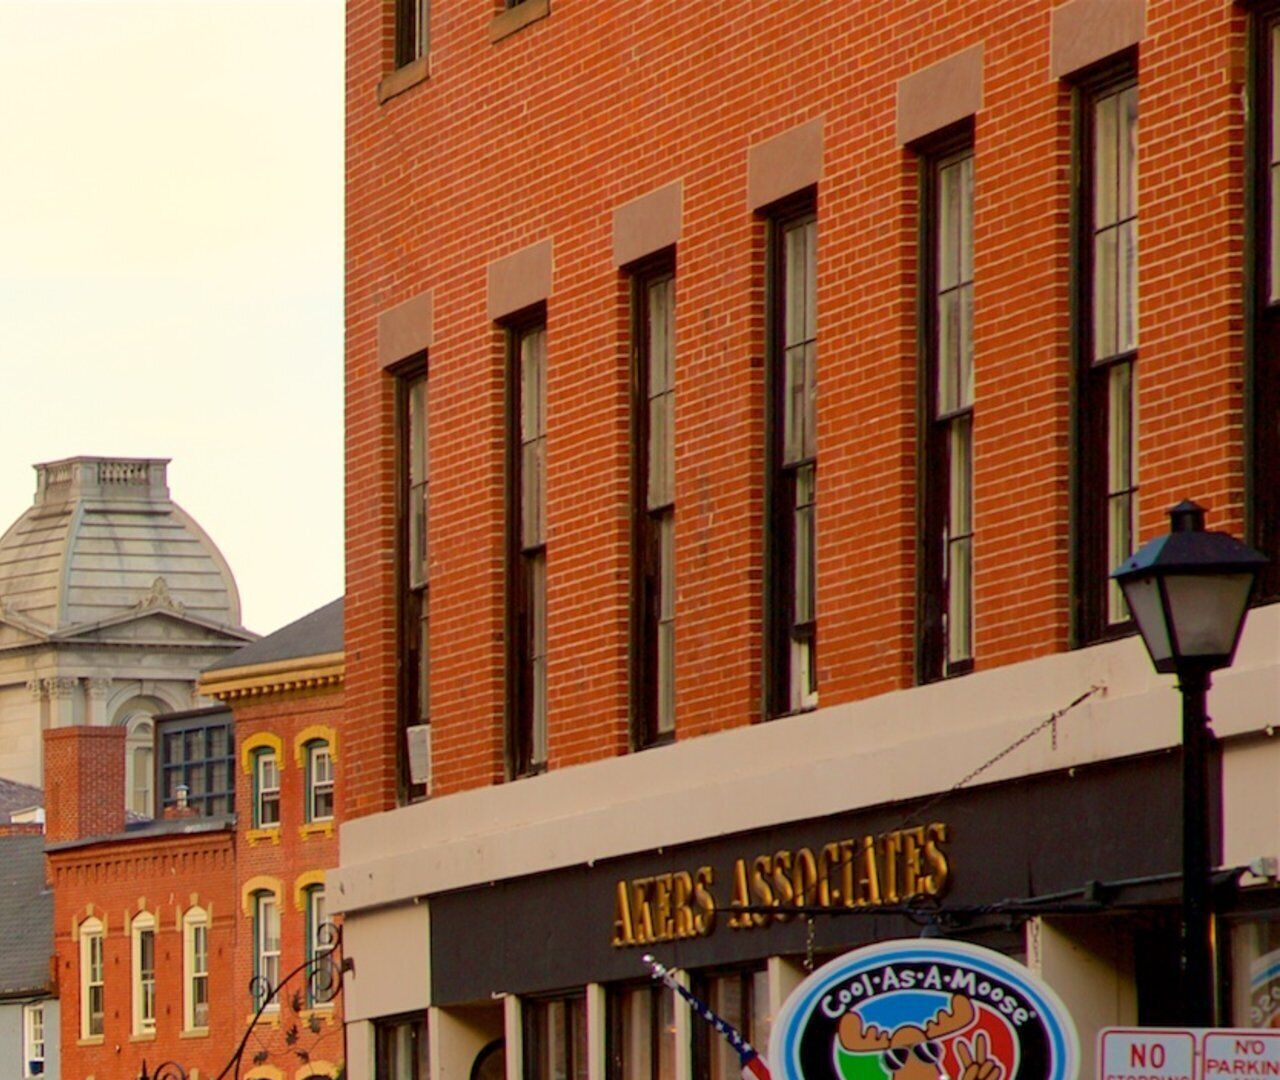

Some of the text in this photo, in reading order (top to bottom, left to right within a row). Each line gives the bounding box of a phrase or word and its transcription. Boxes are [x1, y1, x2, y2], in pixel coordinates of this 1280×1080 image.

[611, 822, 948, 947] AKERS ASSOCIATES
[1130, 1044, 1165, 1068] NO
[1235, 1040, 1266, 1055] NO
[1206, 1059, 1280, 1075] PARKIN
